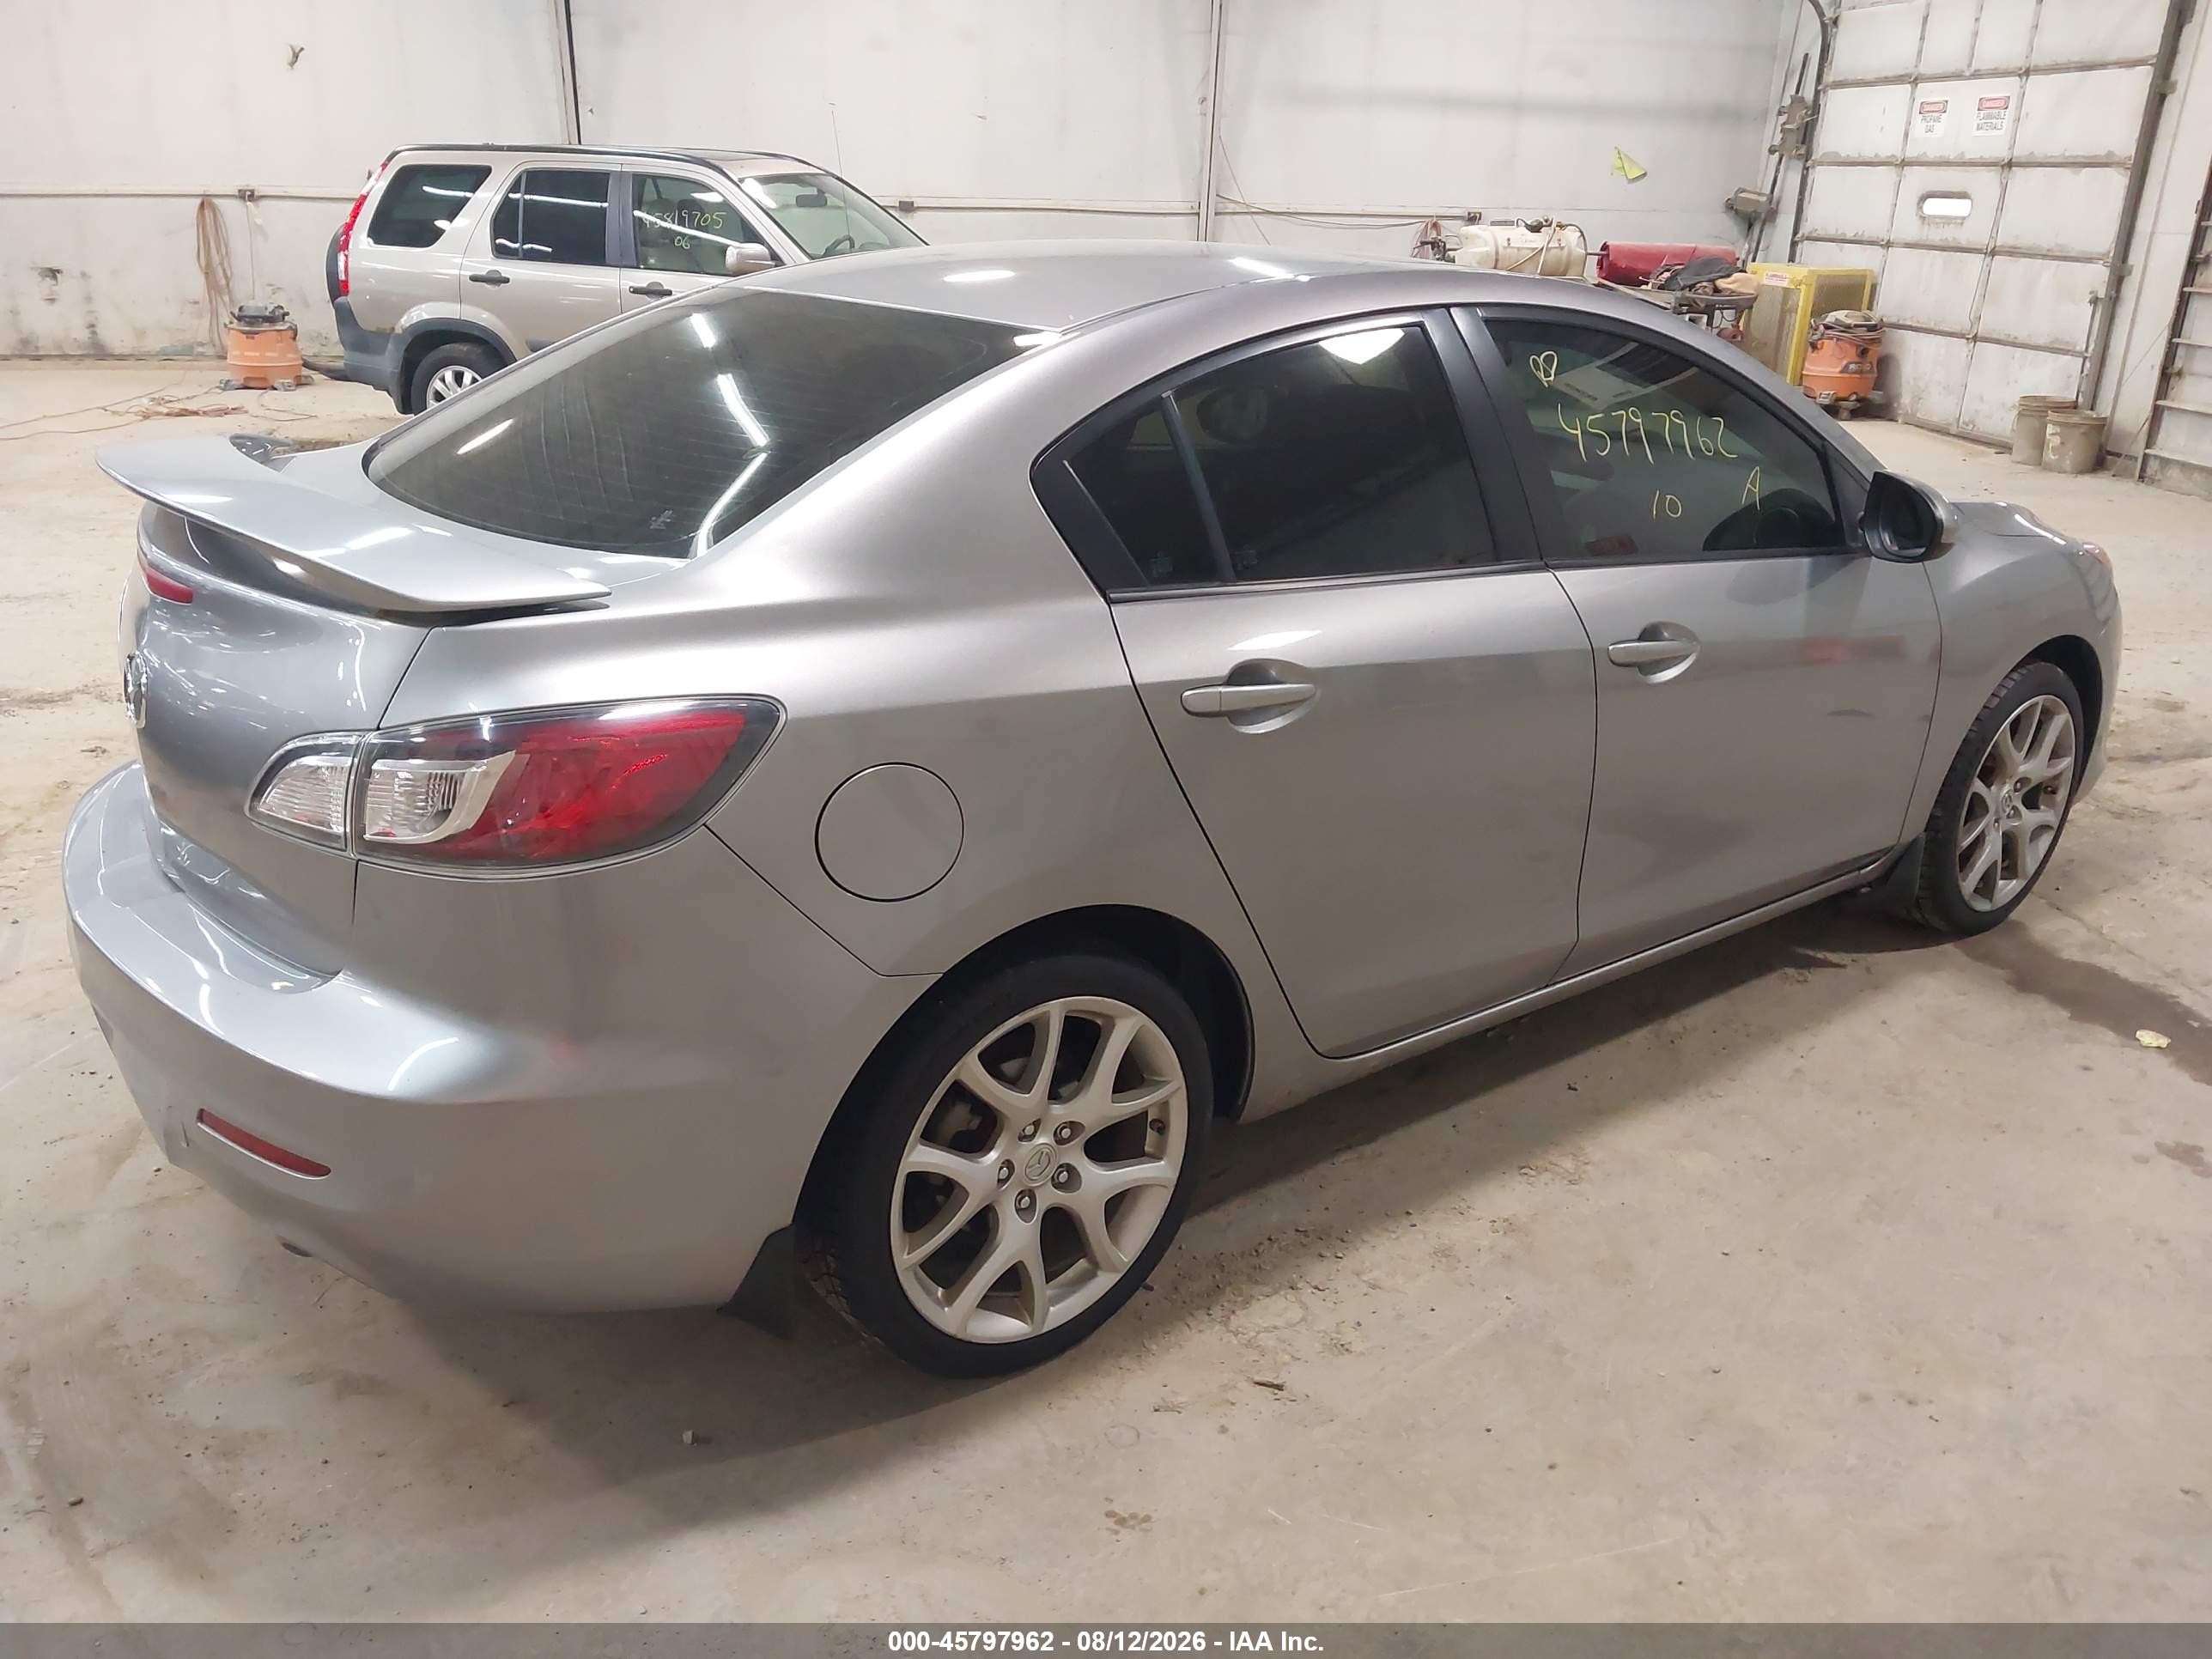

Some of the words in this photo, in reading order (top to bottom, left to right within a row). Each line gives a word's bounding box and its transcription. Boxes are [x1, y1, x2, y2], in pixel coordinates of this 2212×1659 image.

[1976, 121, 2003, 131] MATERIALS
[674, 235, 690, 249] 06
[1557, 403, 1739, 465] 45797962
[1741, 465, 1761, 511] A
[1652, 489, 1683, 519] 10
